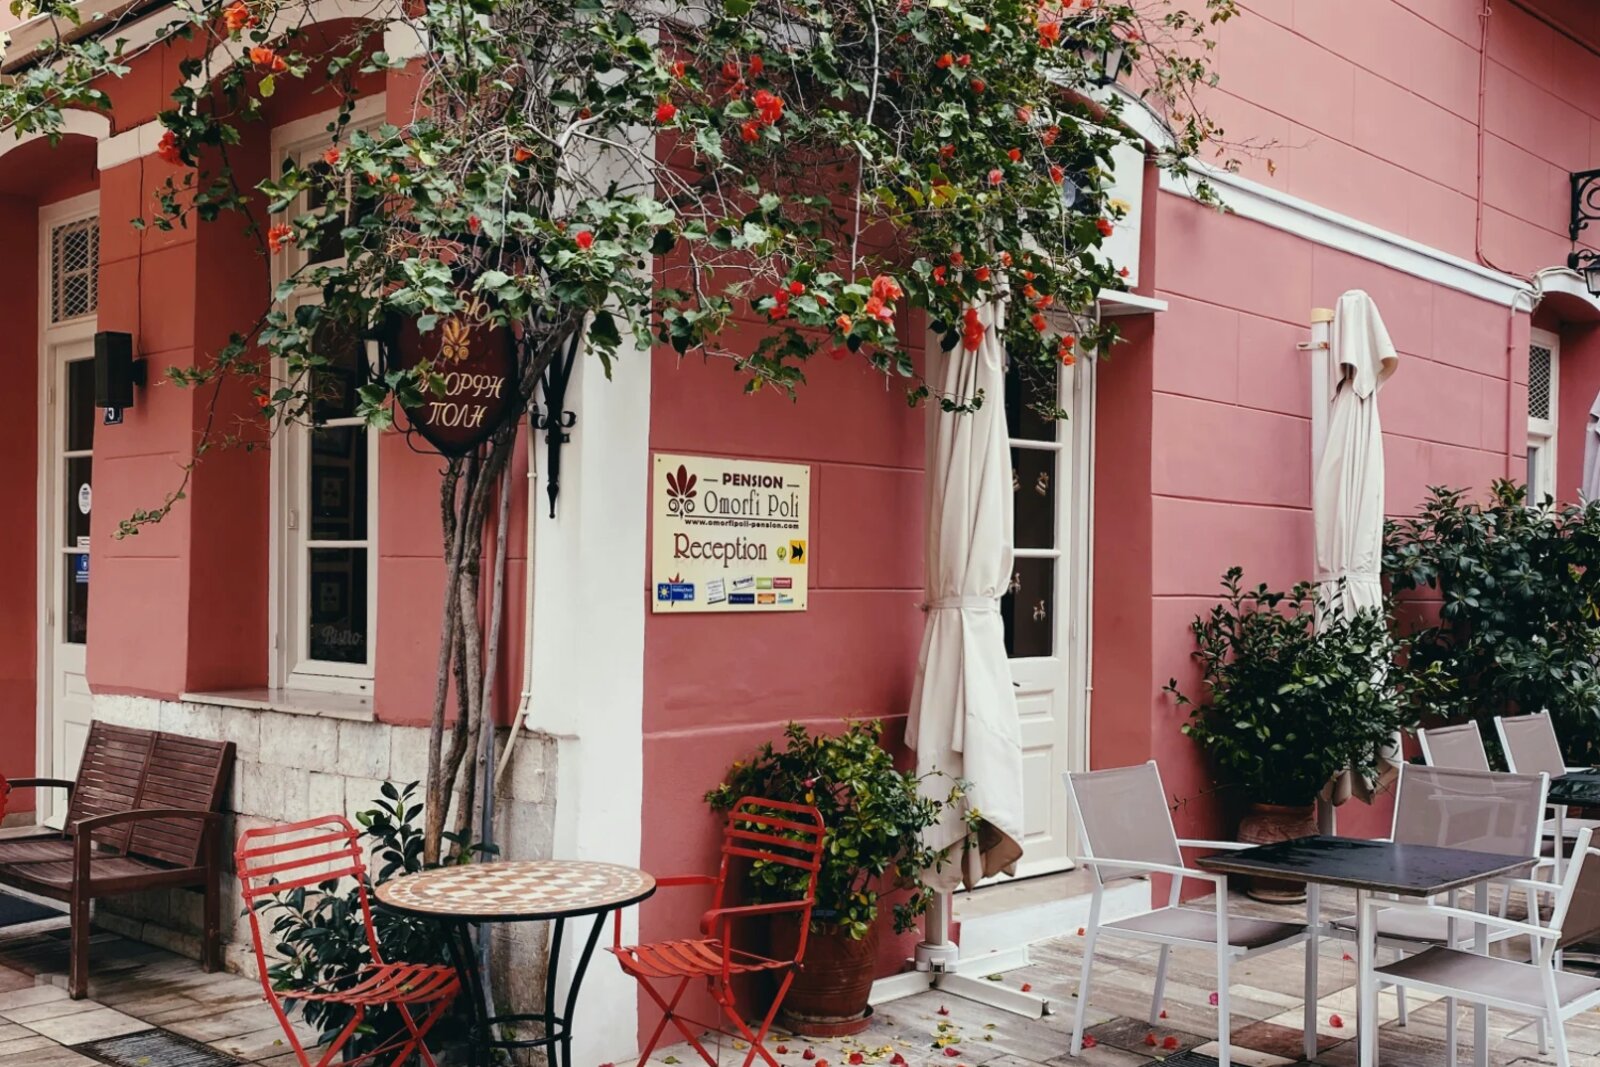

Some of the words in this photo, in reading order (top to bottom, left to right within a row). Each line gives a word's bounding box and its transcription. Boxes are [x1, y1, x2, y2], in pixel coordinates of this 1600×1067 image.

[722, 472, 784, 489] PENSION
[704, 489, 760, 516] Omorfi
[768, 492, 799, 518] Poli
[684, 519, 799, 529] www.omorfipoli-pension.com
[673, 533, 767, 568] Reception
